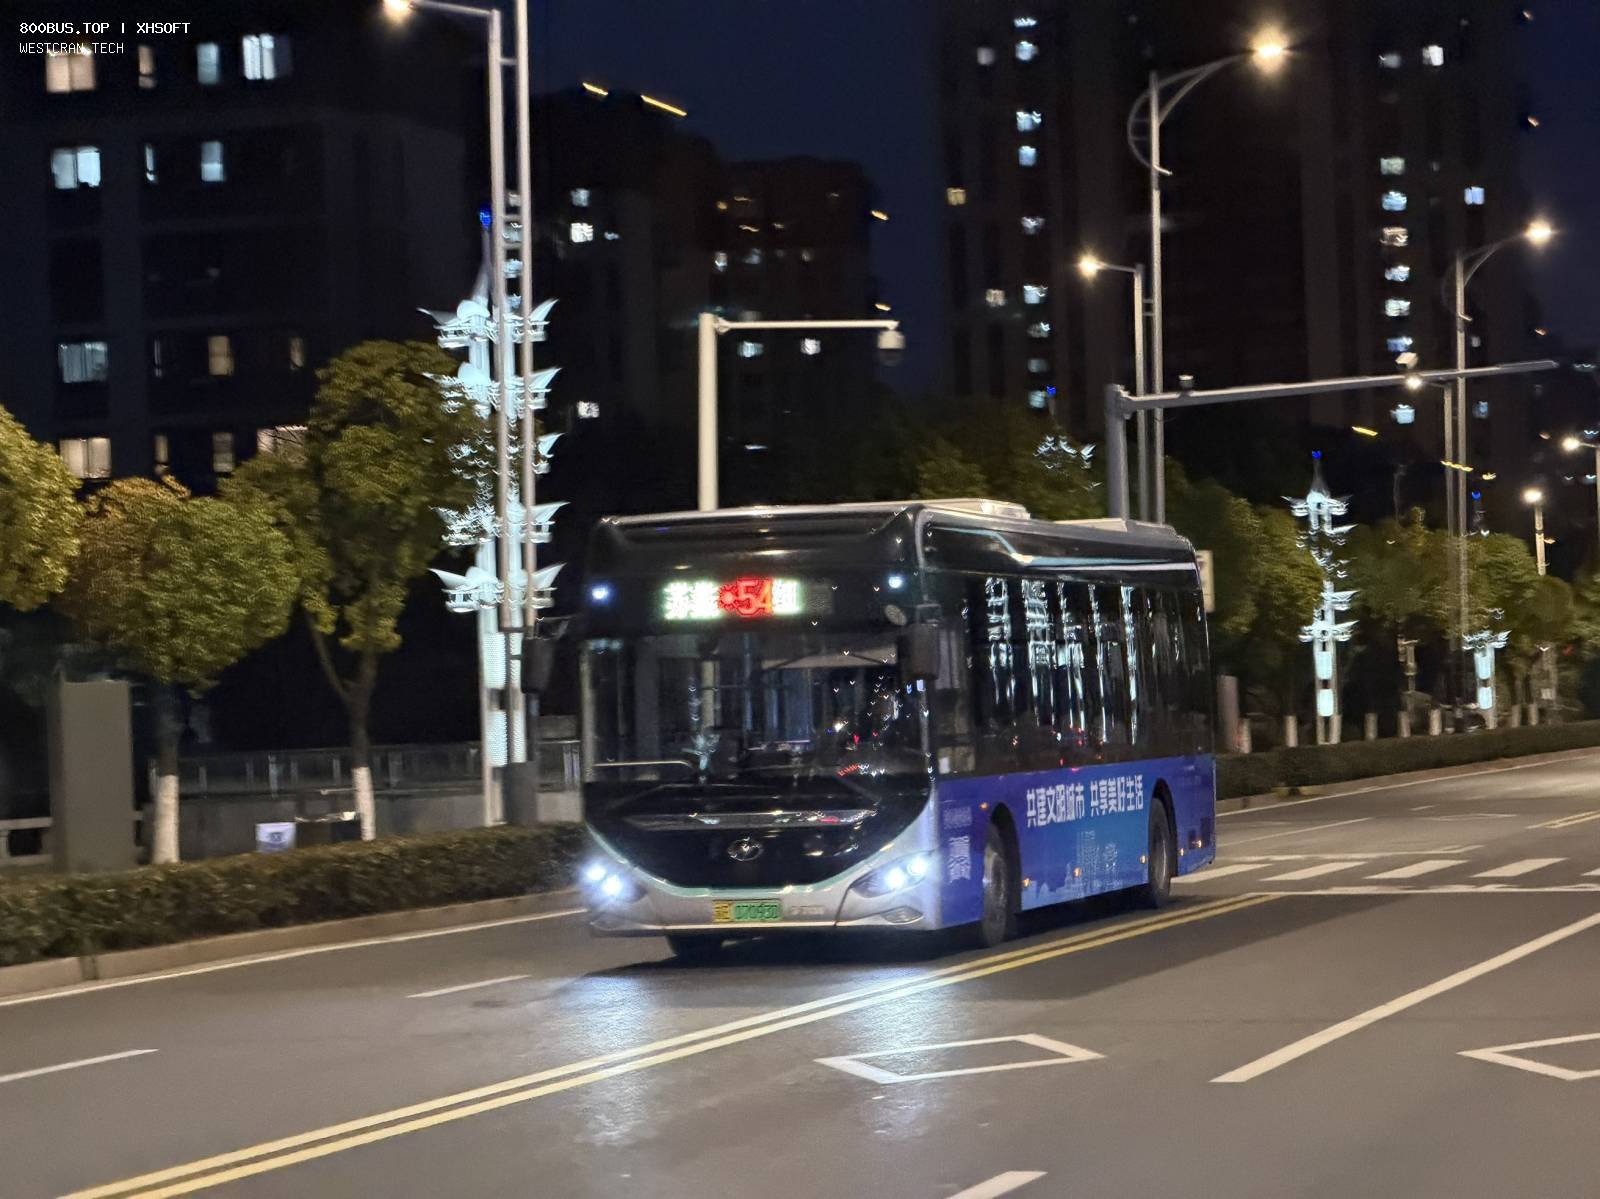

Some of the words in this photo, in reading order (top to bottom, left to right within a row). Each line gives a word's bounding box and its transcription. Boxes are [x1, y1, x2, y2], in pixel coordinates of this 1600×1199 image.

[1090, 774, 1144, 818] 共享美好生活
